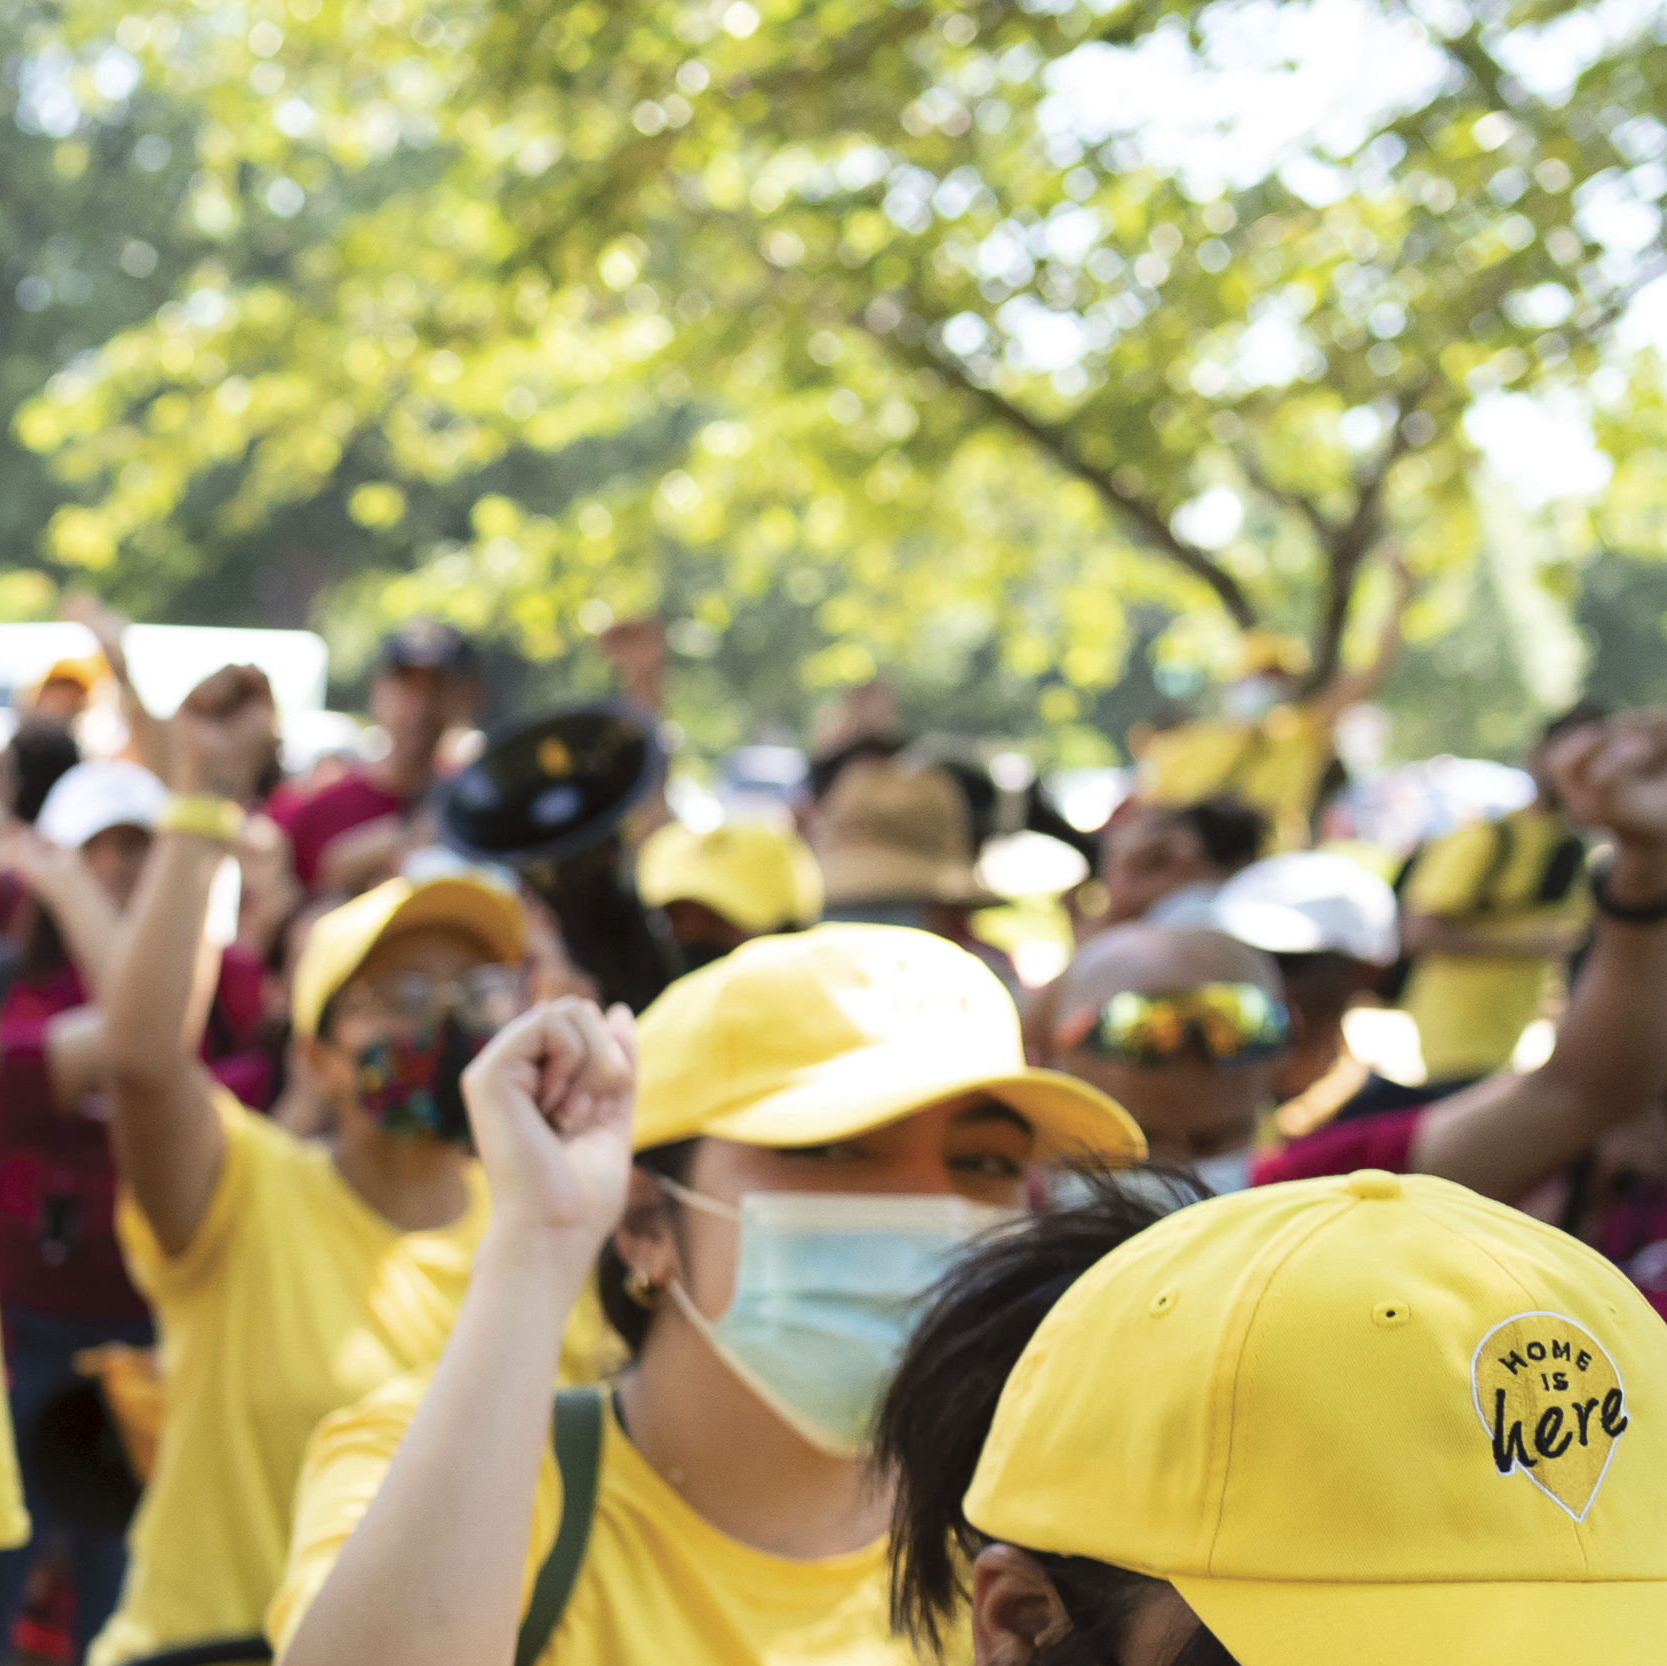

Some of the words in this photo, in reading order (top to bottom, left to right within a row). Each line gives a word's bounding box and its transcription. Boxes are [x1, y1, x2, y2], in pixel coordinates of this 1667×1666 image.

[1498, 1339, 1592, 1375] HOME
[1540, 1372, 1569, 1391] IS
[1492, 1388, 1628, 1473] here
